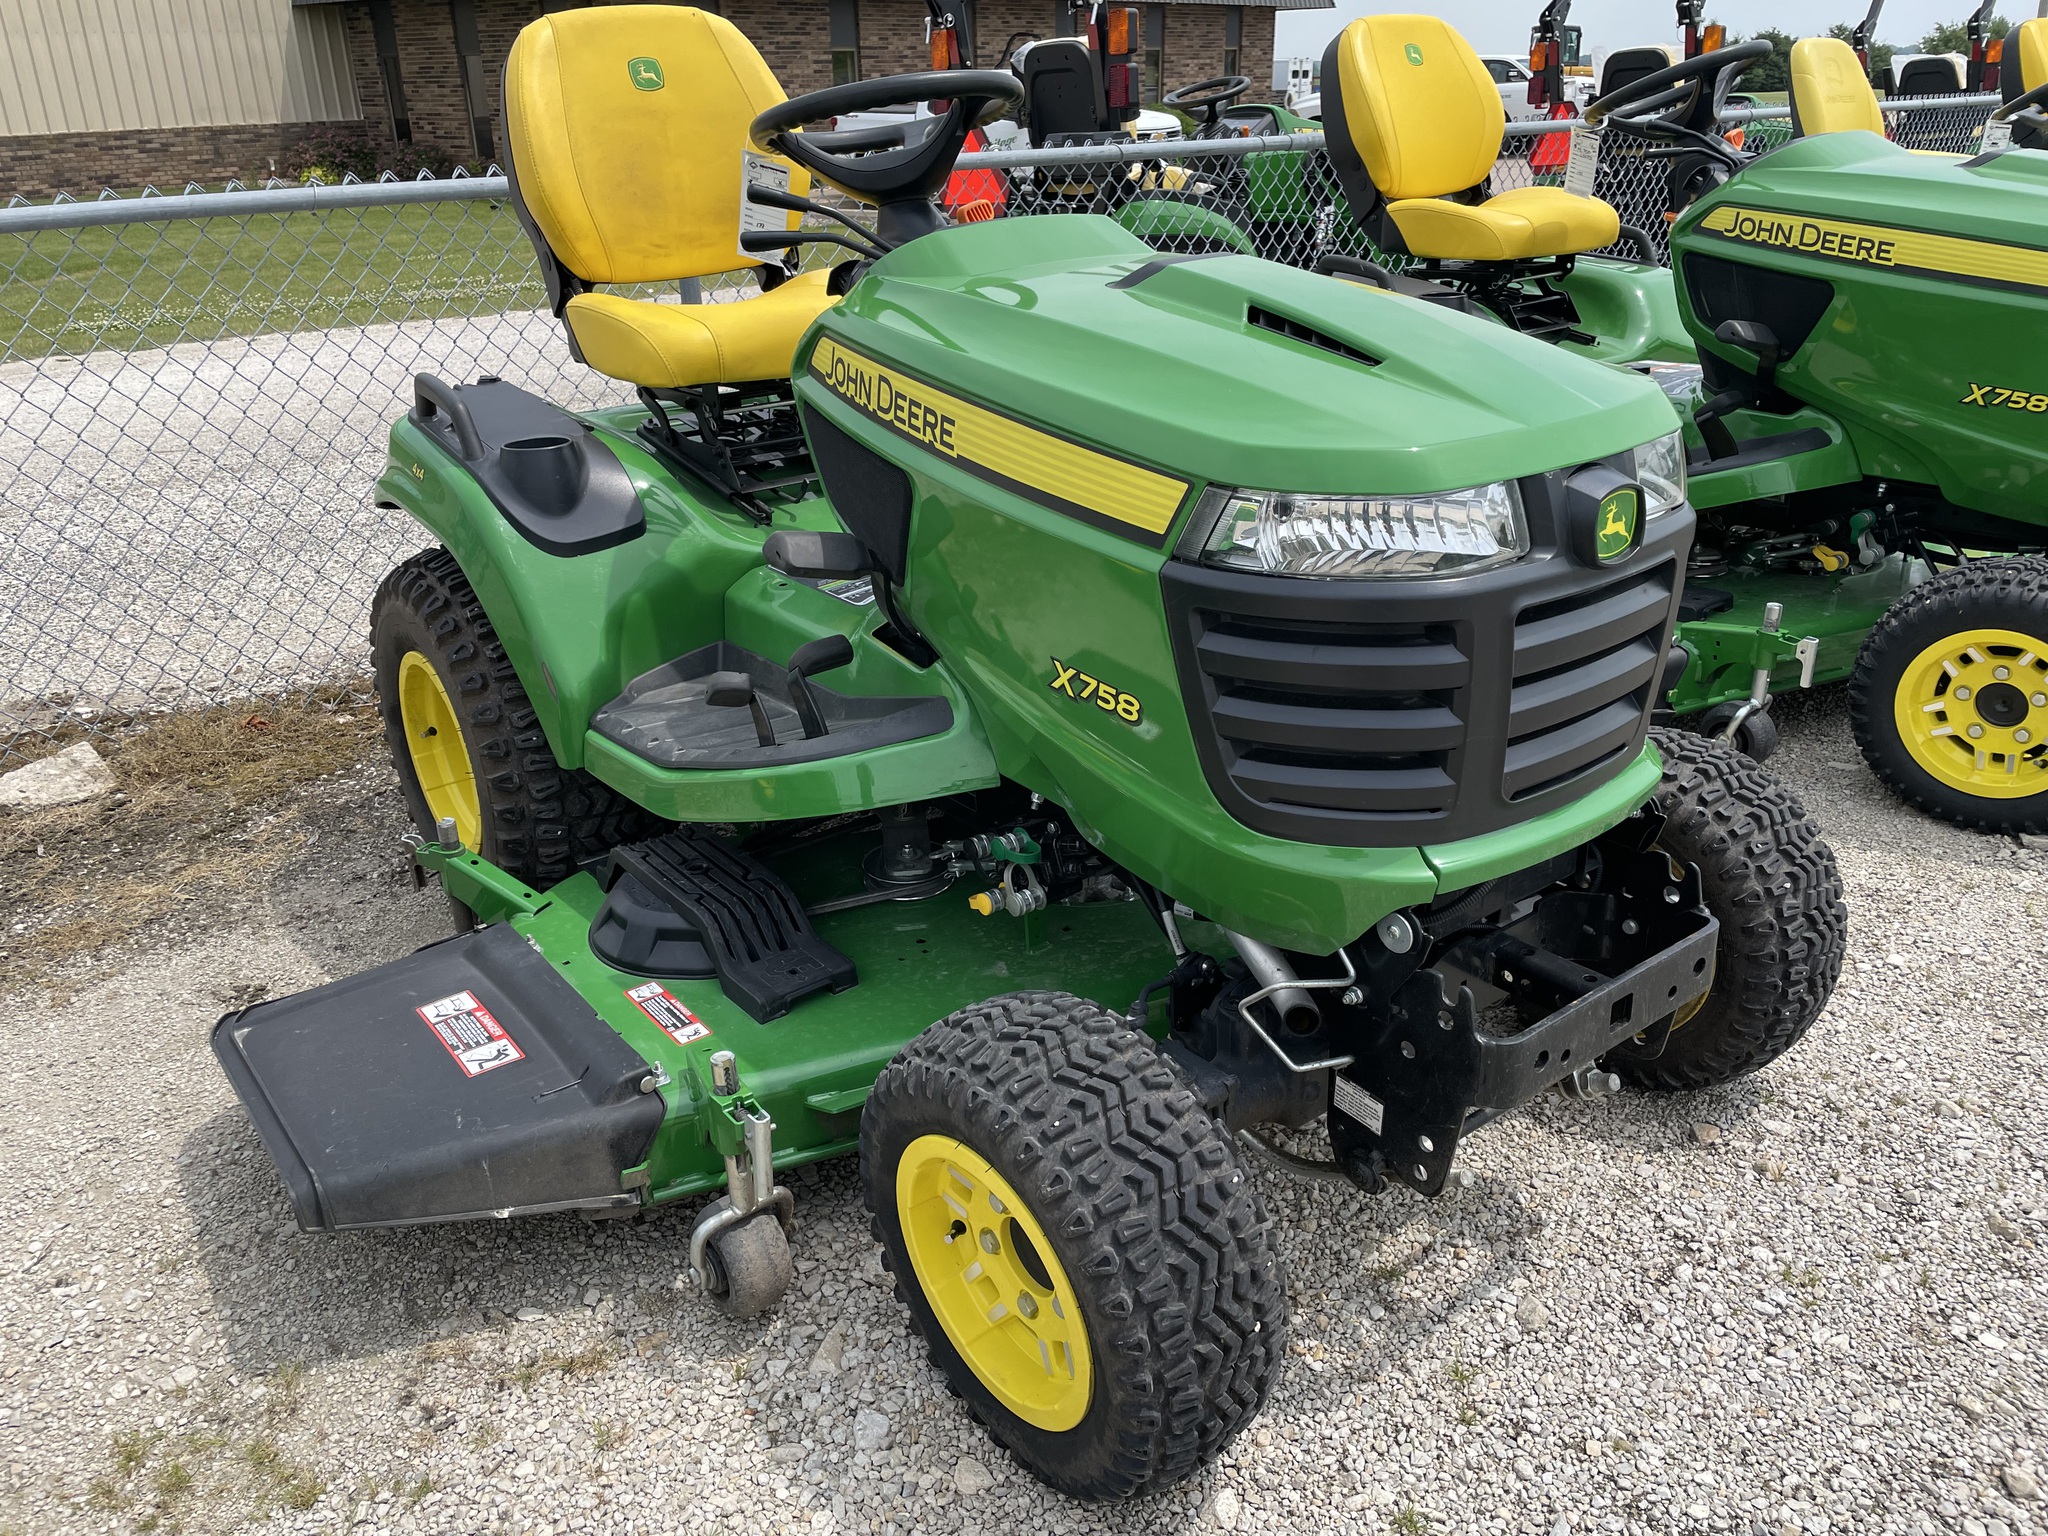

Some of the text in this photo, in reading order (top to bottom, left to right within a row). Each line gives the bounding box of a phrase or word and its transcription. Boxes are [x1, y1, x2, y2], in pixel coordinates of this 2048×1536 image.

[1723, 211, 1895, 263] JOHN DEERE
[825, 346, 956, 453] JOHN DEERE
[1960, 383, 2048, 413] X758
[1049, 657, 1142, 722] X758
[479, 1014, 504, 1037] DANGER
